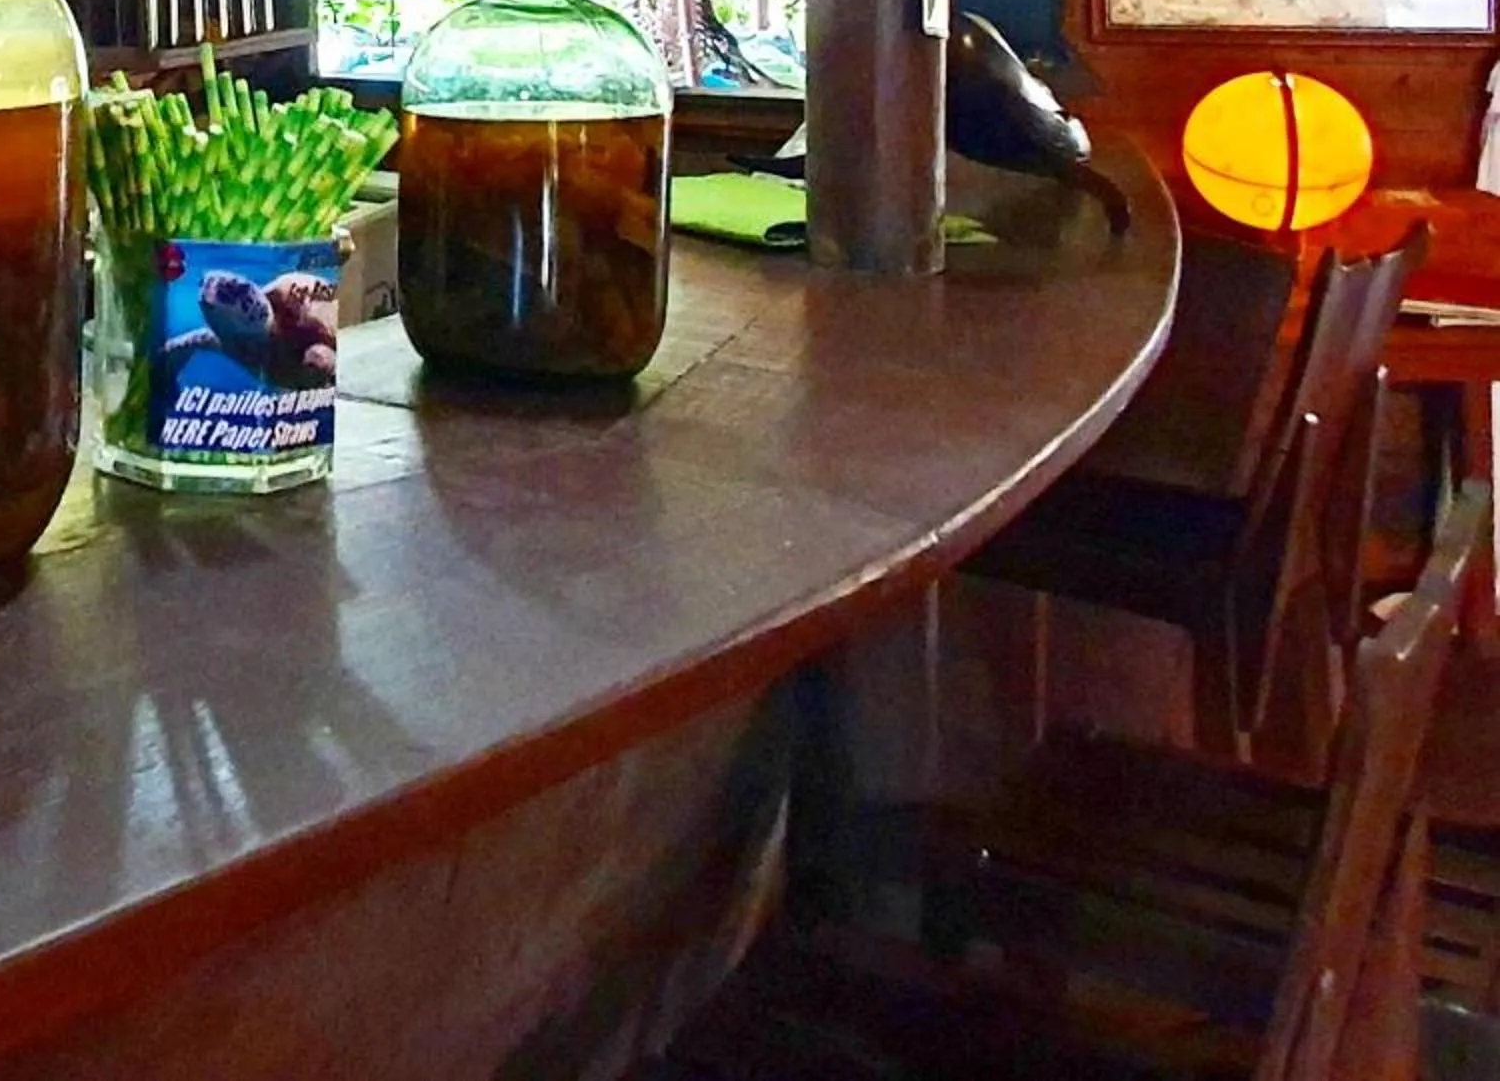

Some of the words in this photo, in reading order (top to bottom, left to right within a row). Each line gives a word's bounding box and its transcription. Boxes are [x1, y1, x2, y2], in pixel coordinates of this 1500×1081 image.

[175, 386, 211, 412] ICI
[206, 389, 277, 417] pailles
[161, 418, 211, 445] HERE
[209, 420, 273, 449] Paper
